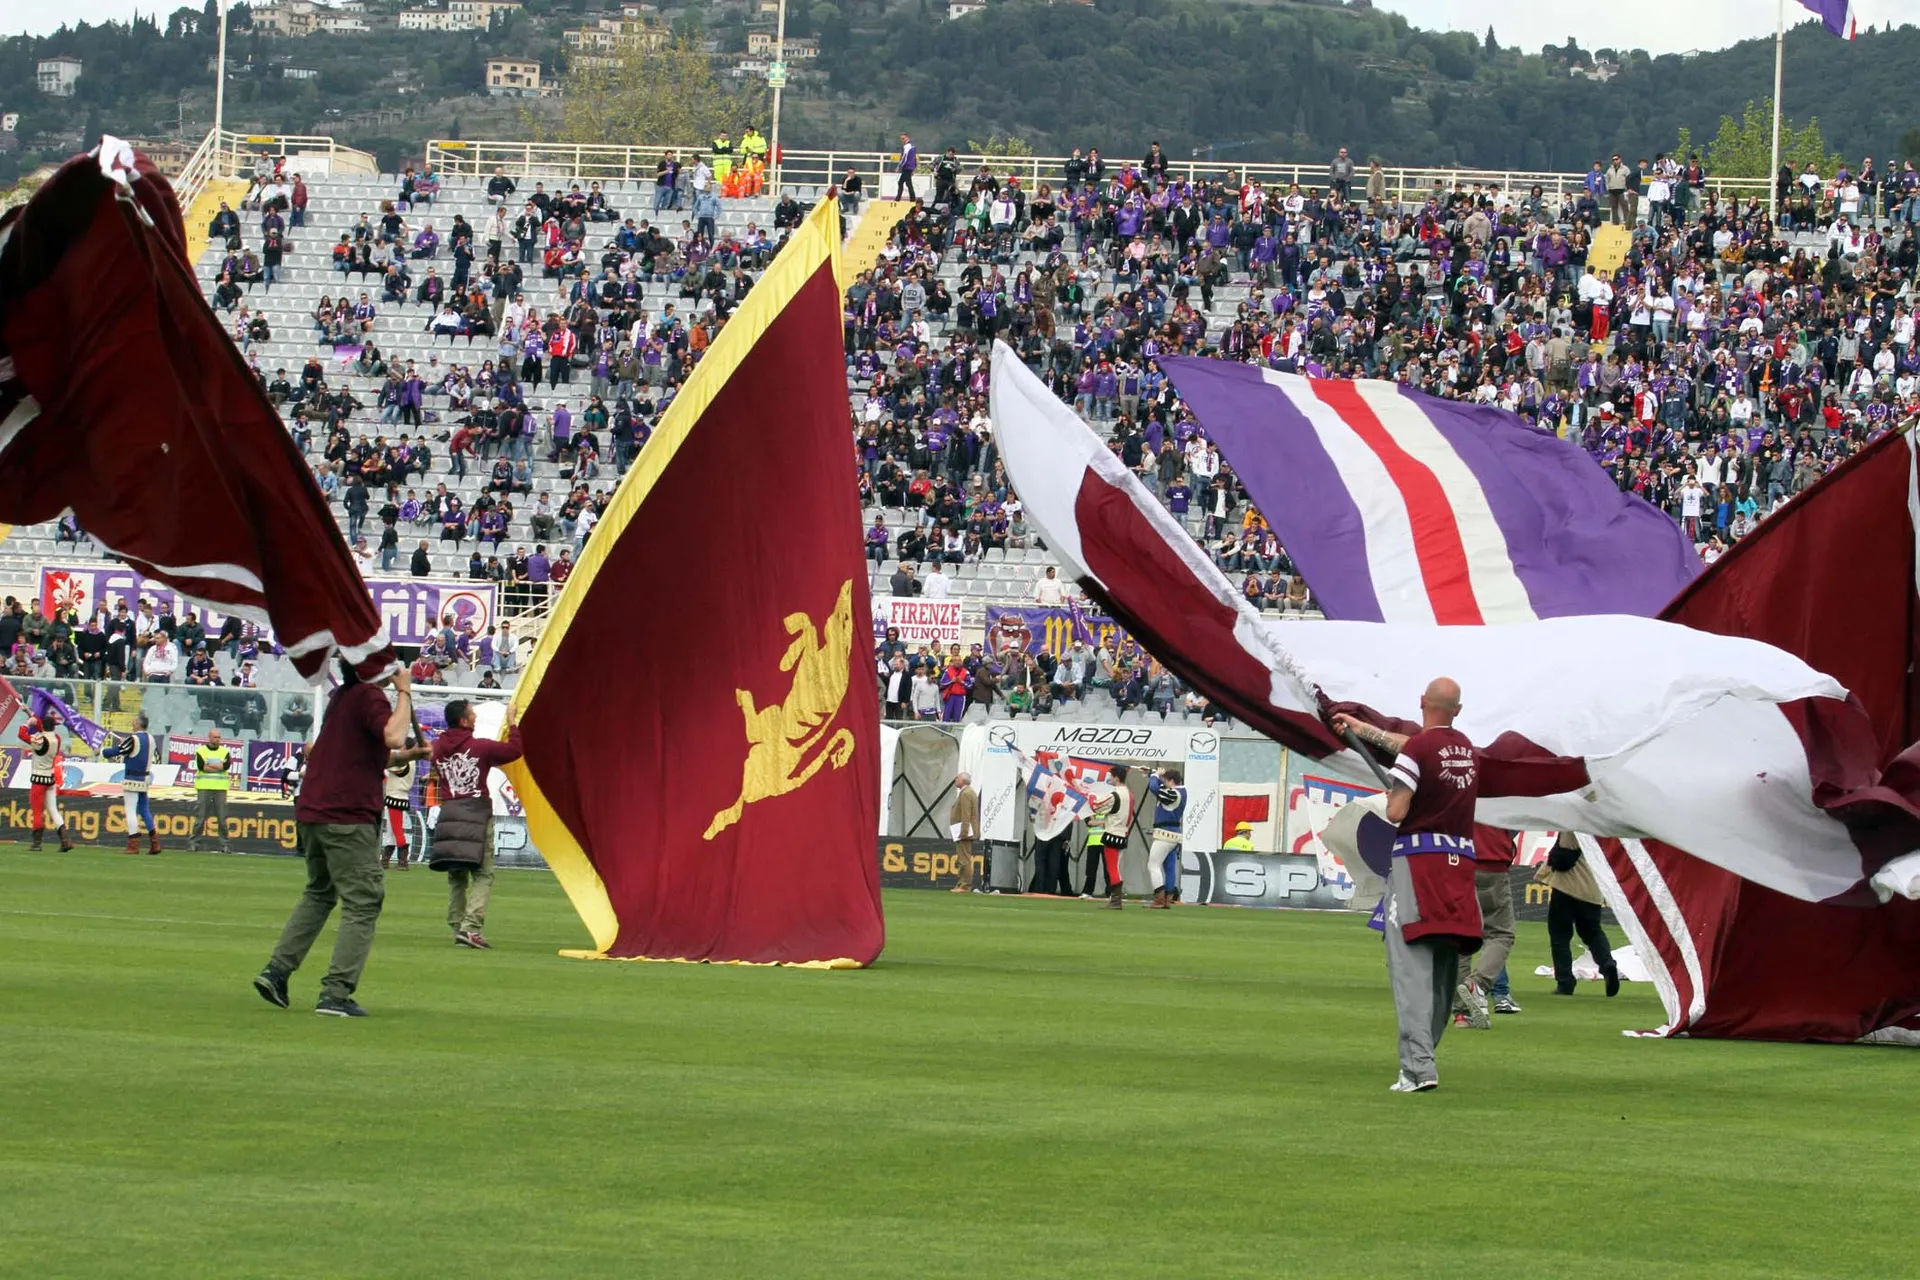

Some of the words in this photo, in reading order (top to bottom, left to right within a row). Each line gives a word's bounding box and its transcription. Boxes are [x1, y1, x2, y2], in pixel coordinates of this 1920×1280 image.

[890, 602, 961, 626] FIRENZE
[895, 626, 959, 640] VUNQUE
[1076, 746, 1168, 758] CONVENTION
[883, 843, 907, 872] &
